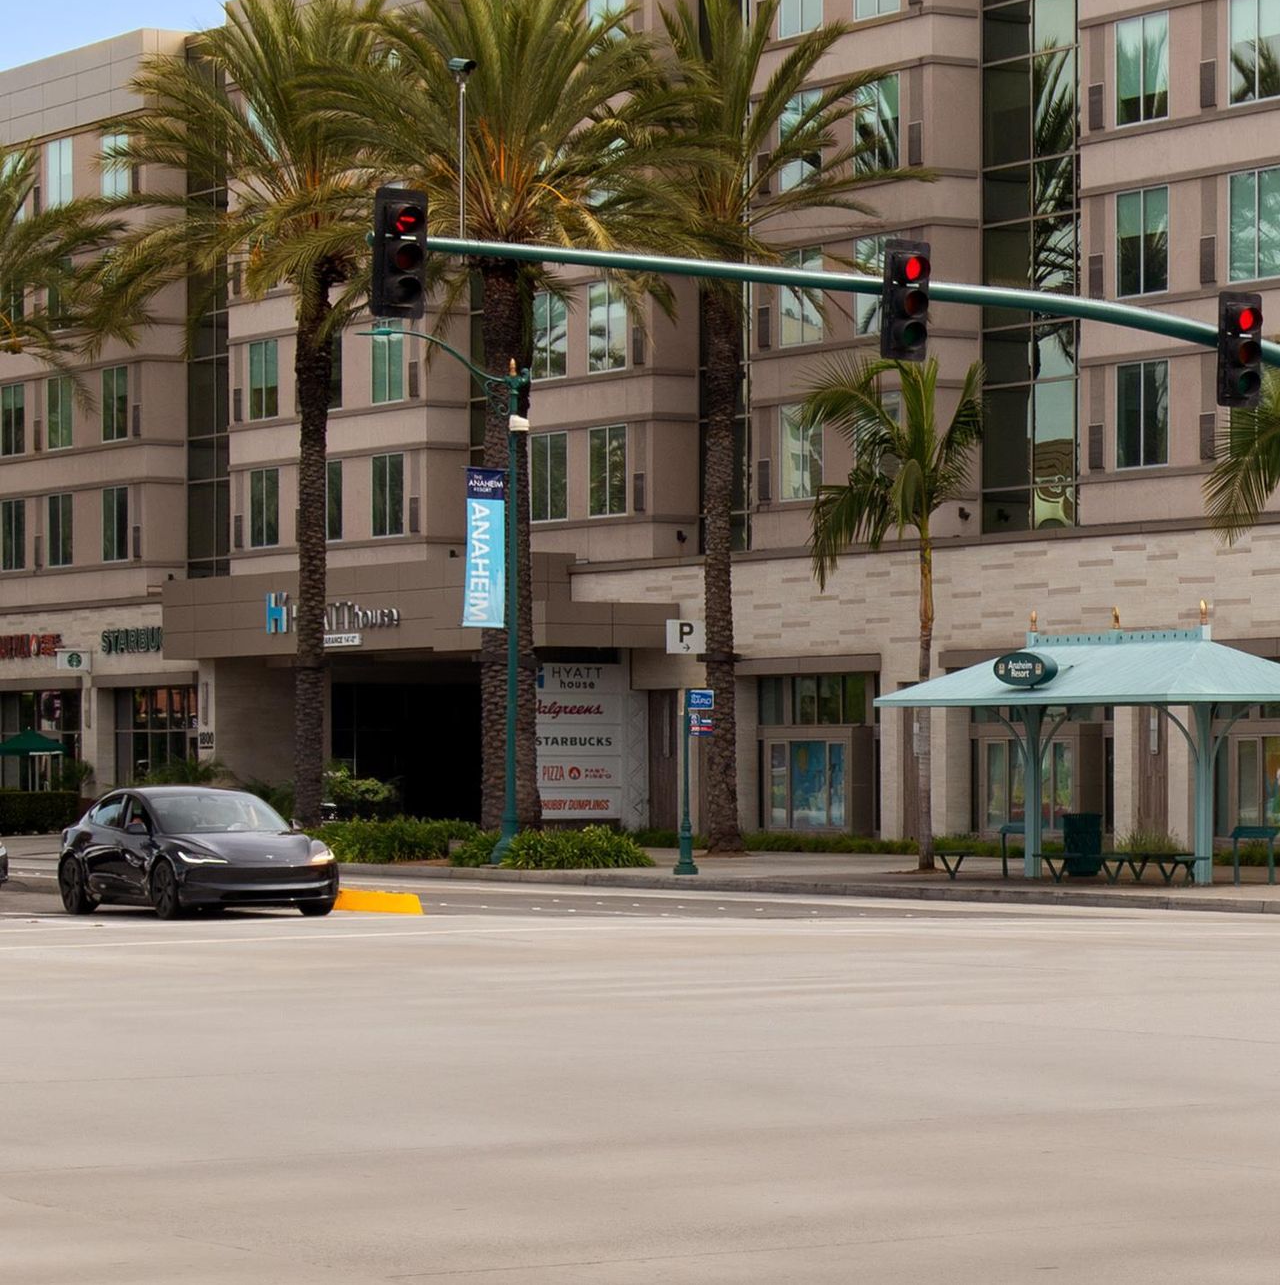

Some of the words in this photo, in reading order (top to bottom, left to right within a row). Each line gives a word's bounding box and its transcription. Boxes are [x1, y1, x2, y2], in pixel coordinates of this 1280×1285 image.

[468, 479, 504, 488] ANAHEIM
[469, 502, 491, 621] ANAHEIM
[352, 604, 401, 629] house
[679, 622, 694, 643] P
[102, 626, 163, 655] STARBU
[1008, 660, 1033, 670] Anaheim
[552, 666, 603, 679] HYATT
[1011, 669, 1030, 678] Resort
[560, 679, 595, 689] house
[200, 731, 215, 745] 1800
[536, 736, 613, 747] STARBUCKS
[542, 765, 565, 781] PIZZA
[568, 799, 611, 811] DUMPLINGS
